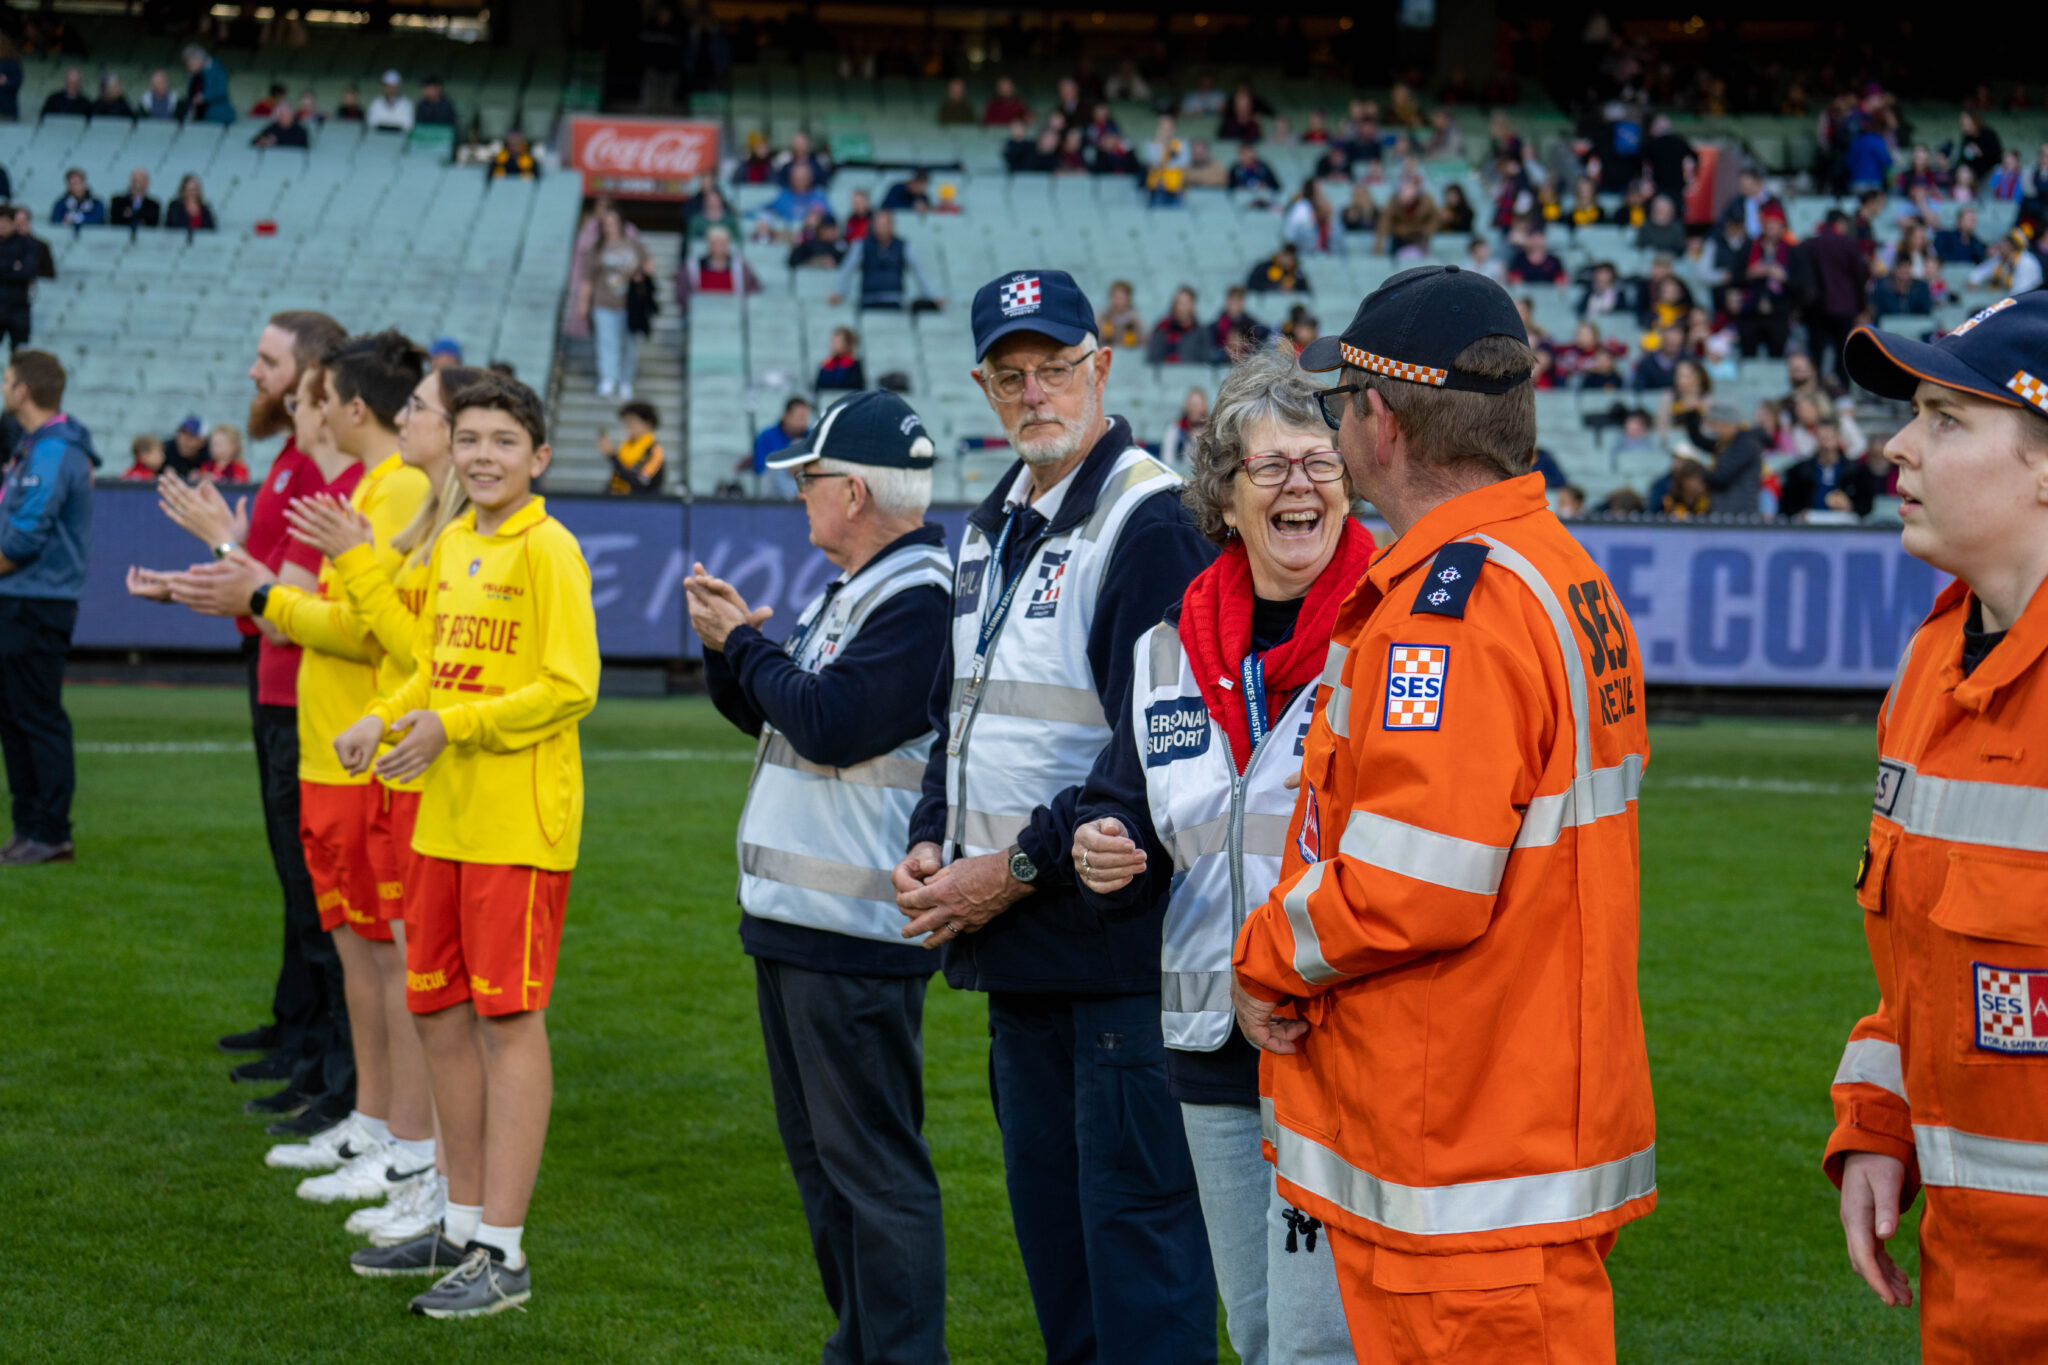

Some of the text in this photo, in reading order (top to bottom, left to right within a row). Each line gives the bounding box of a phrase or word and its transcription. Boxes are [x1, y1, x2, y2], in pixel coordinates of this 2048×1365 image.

[447, 614, 522, 655] RESCUE
[984, 607, 1005, 640] MINISTRY
[1568, 578, 1627, 677] SES
[1391, 676, 1440, 698] SES
[1151, 708, 1207, 733] ERSONAL
[1249, 699, 1262, 743] MINISTRY
[1982, 993, 2023, 1015] SES
[1983, 1035, 2000, 1045] FOR
[2010, 1041, 2036, 1049] SAFER
